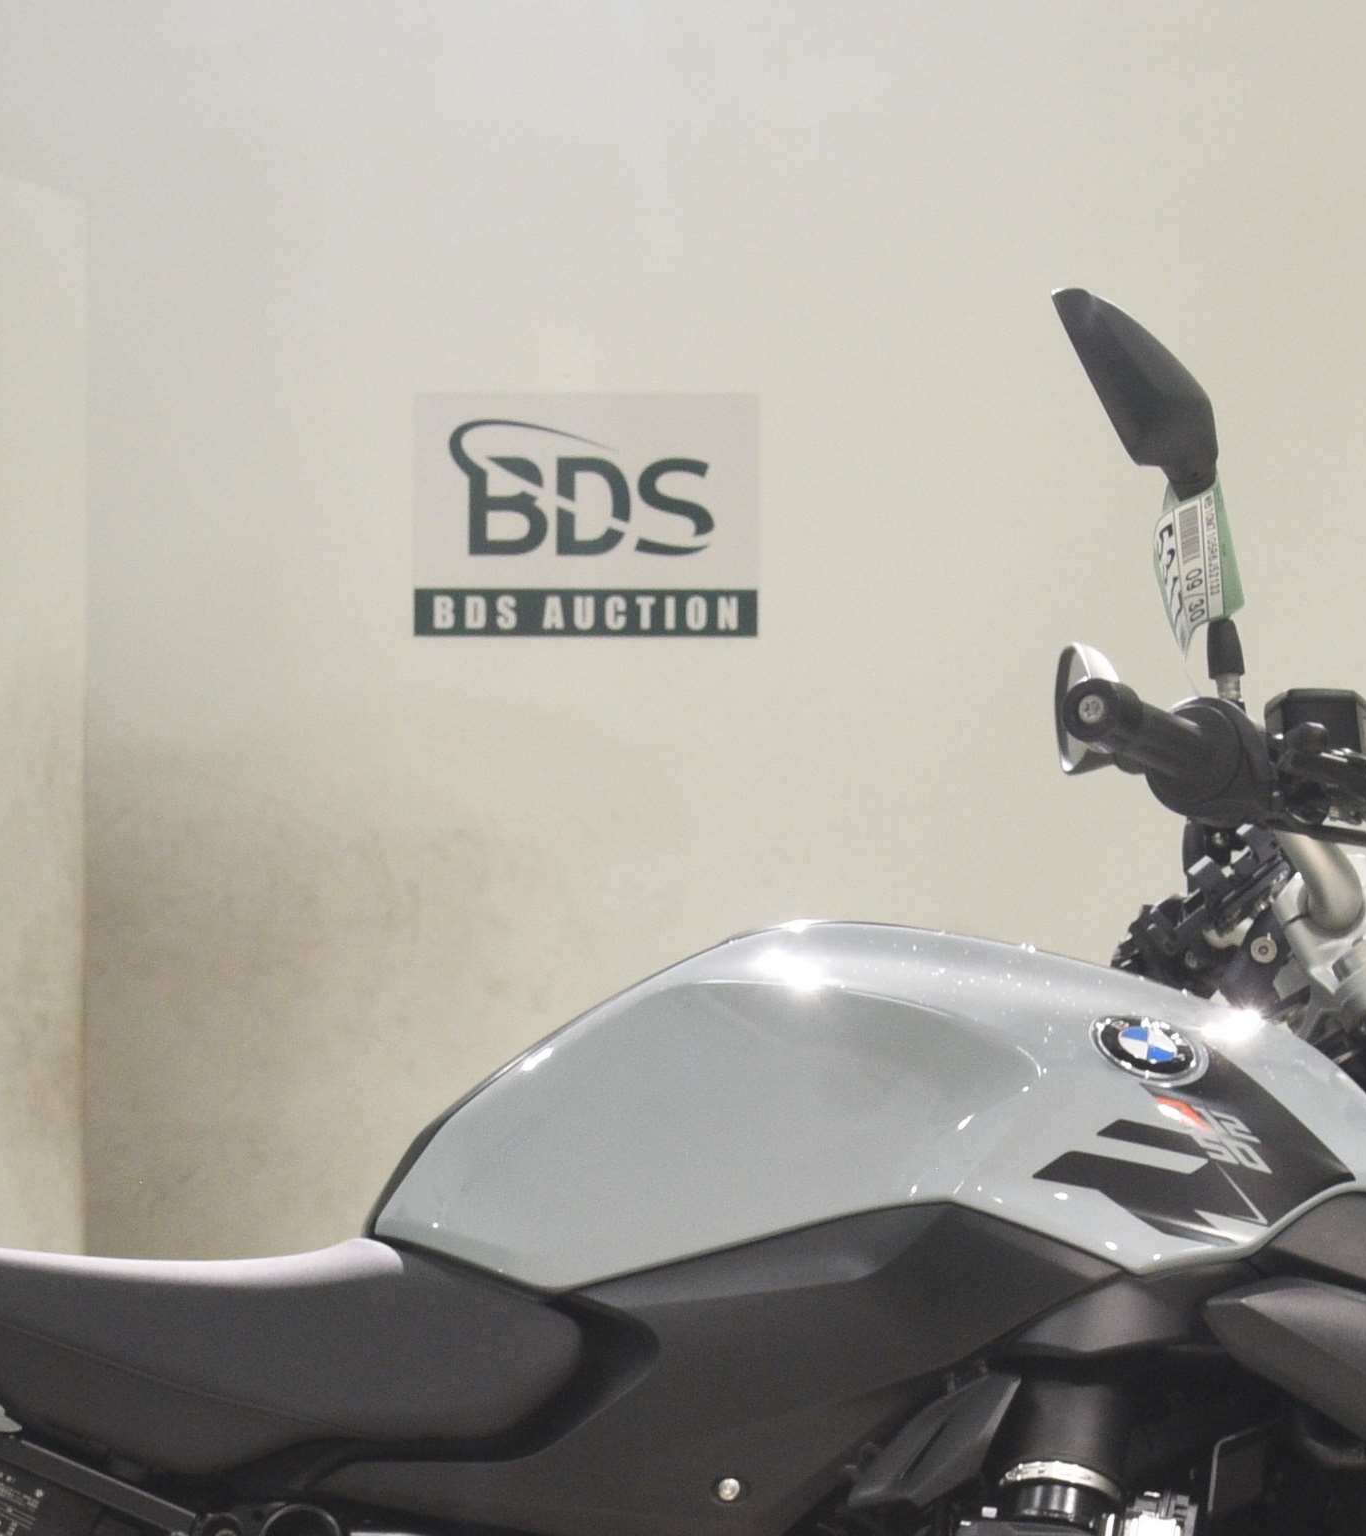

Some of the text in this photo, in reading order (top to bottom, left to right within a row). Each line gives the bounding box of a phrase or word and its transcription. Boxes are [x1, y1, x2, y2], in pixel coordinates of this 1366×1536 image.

[449, 419, 715, 556] BDS
[432, 594, 739, 631] BDS AUCTION
